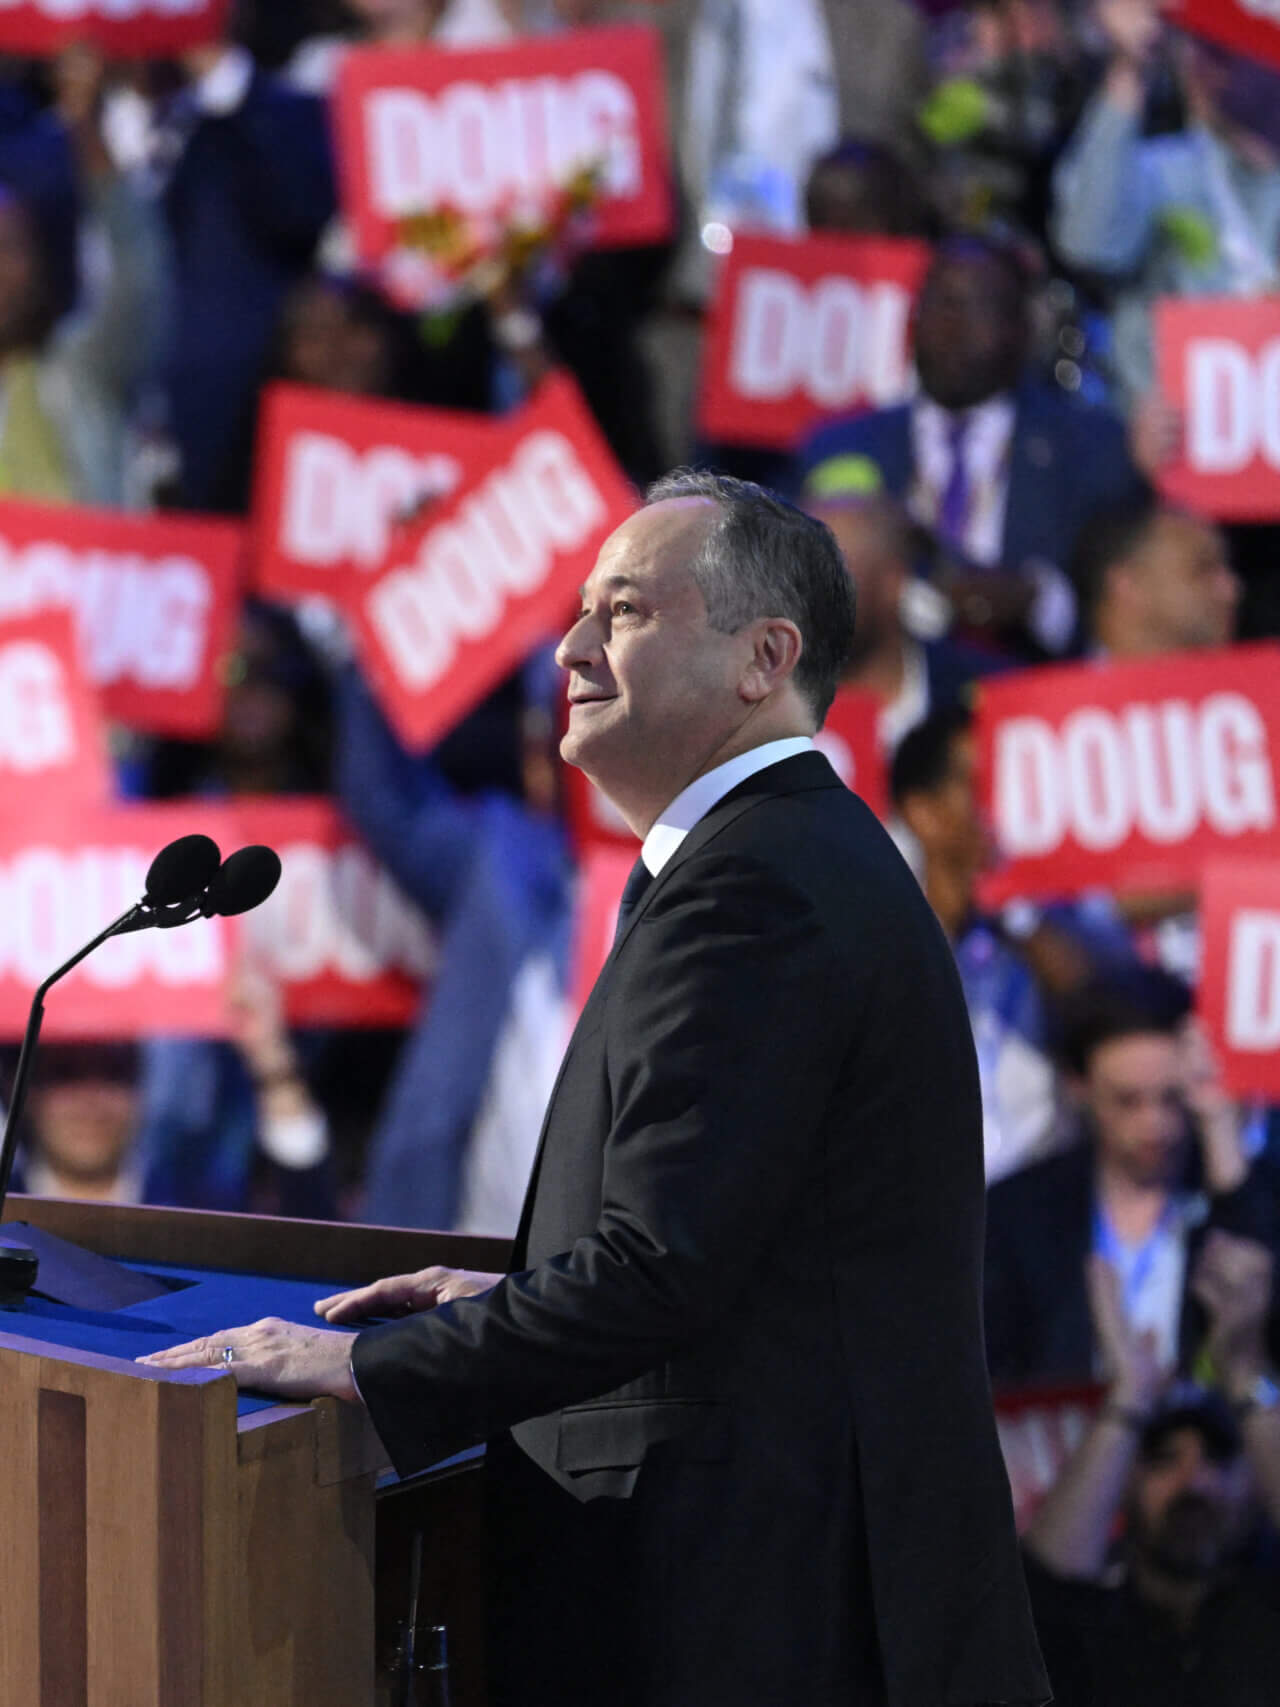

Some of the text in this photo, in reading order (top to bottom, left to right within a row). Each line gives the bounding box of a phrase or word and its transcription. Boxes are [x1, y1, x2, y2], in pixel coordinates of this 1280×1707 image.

[368, 72, 641, 218] DOUG
[370, 431, 604, 692] DOUG
[993, 692, 1275, 857] DOUG
